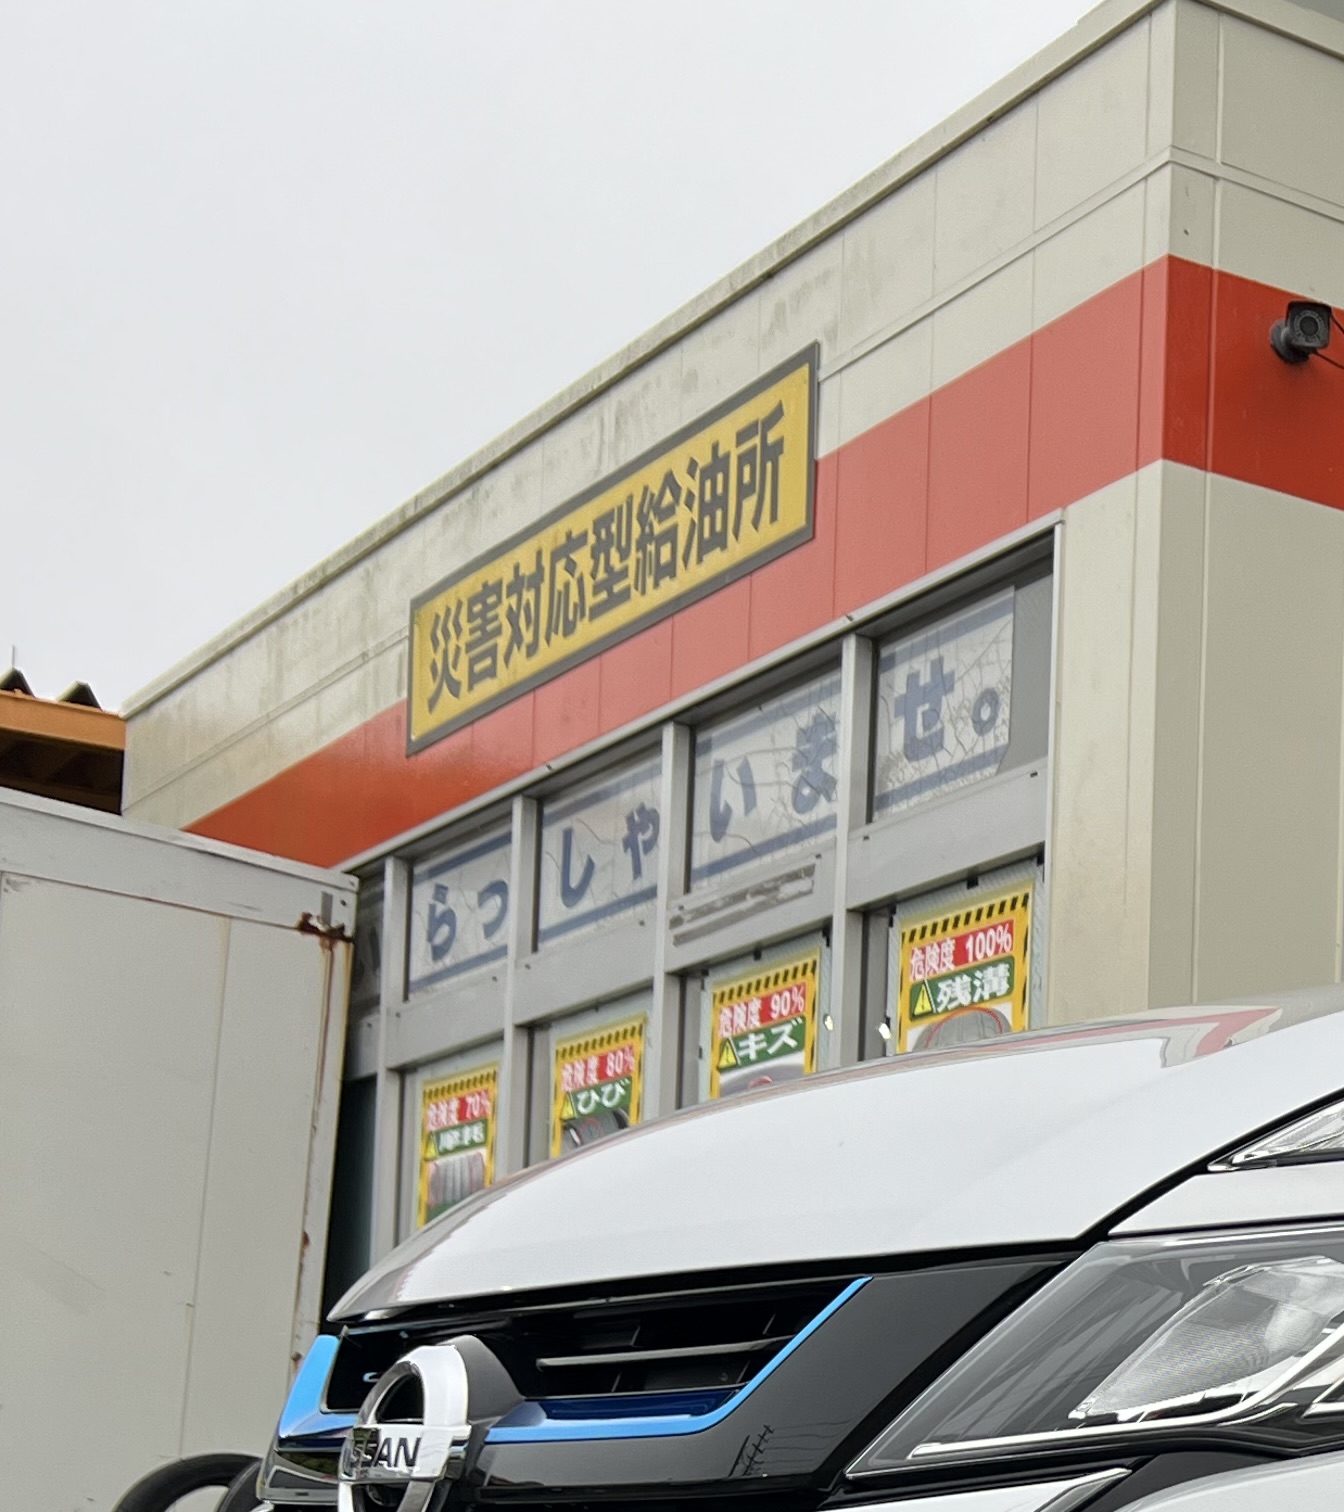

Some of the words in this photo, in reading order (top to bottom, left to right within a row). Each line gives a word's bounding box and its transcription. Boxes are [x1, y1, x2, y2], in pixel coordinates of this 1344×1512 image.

[427, 399, 786, 713] 災害対応型給油所
[909, 938, 957, 981] 危険度
[965, 923, 1013, 962] 100%
[770, 985, 806, 1020] 90%
[936, 963, 1011, 1013] 残溝
[737, 1017, 804, 1060] キズ
[605, 1045, 635, 1077] 80%
[576, 1078, 631, 1115] ひび
